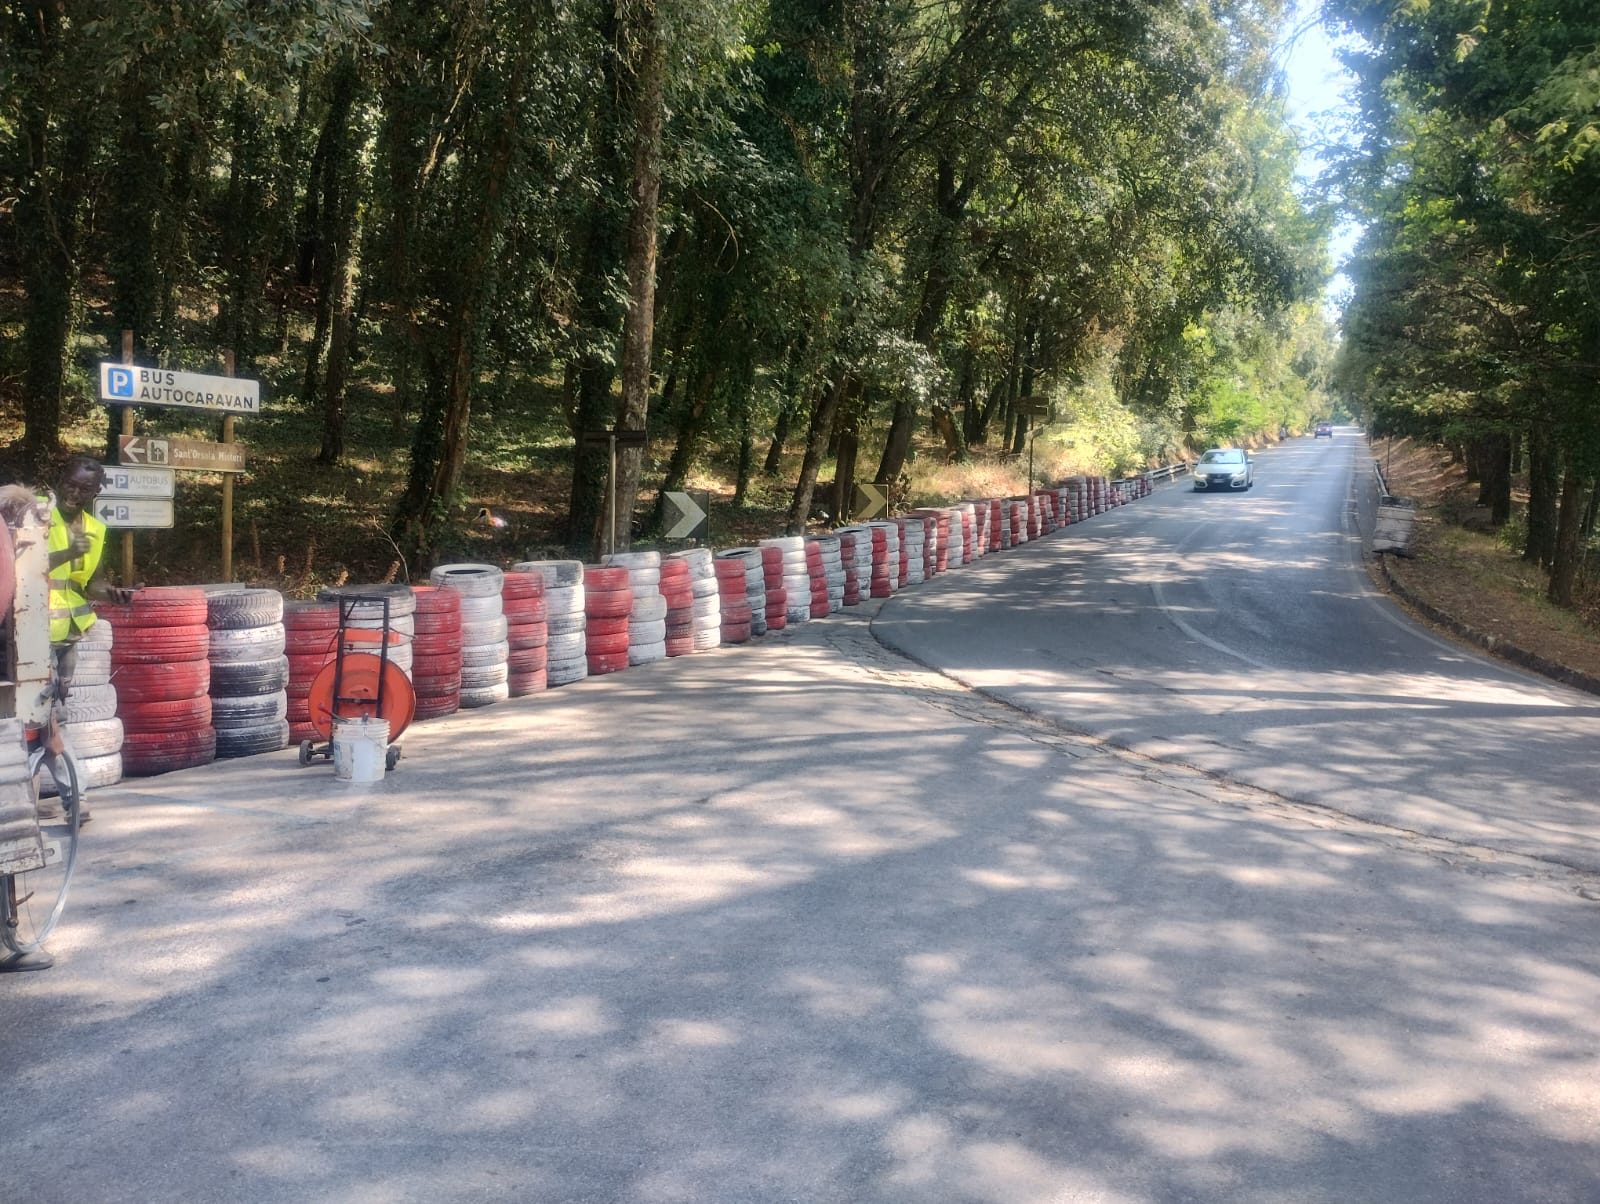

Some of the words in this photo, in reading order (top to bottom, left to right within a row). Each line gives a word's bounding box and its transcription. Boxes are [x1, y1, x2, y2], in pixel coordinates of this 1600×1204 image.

[140, 370, 175, 386] BUS
[140, 386, 254, 409] AUTOCARAVAN
[130, 475, 169, 486] AUTOBUS
